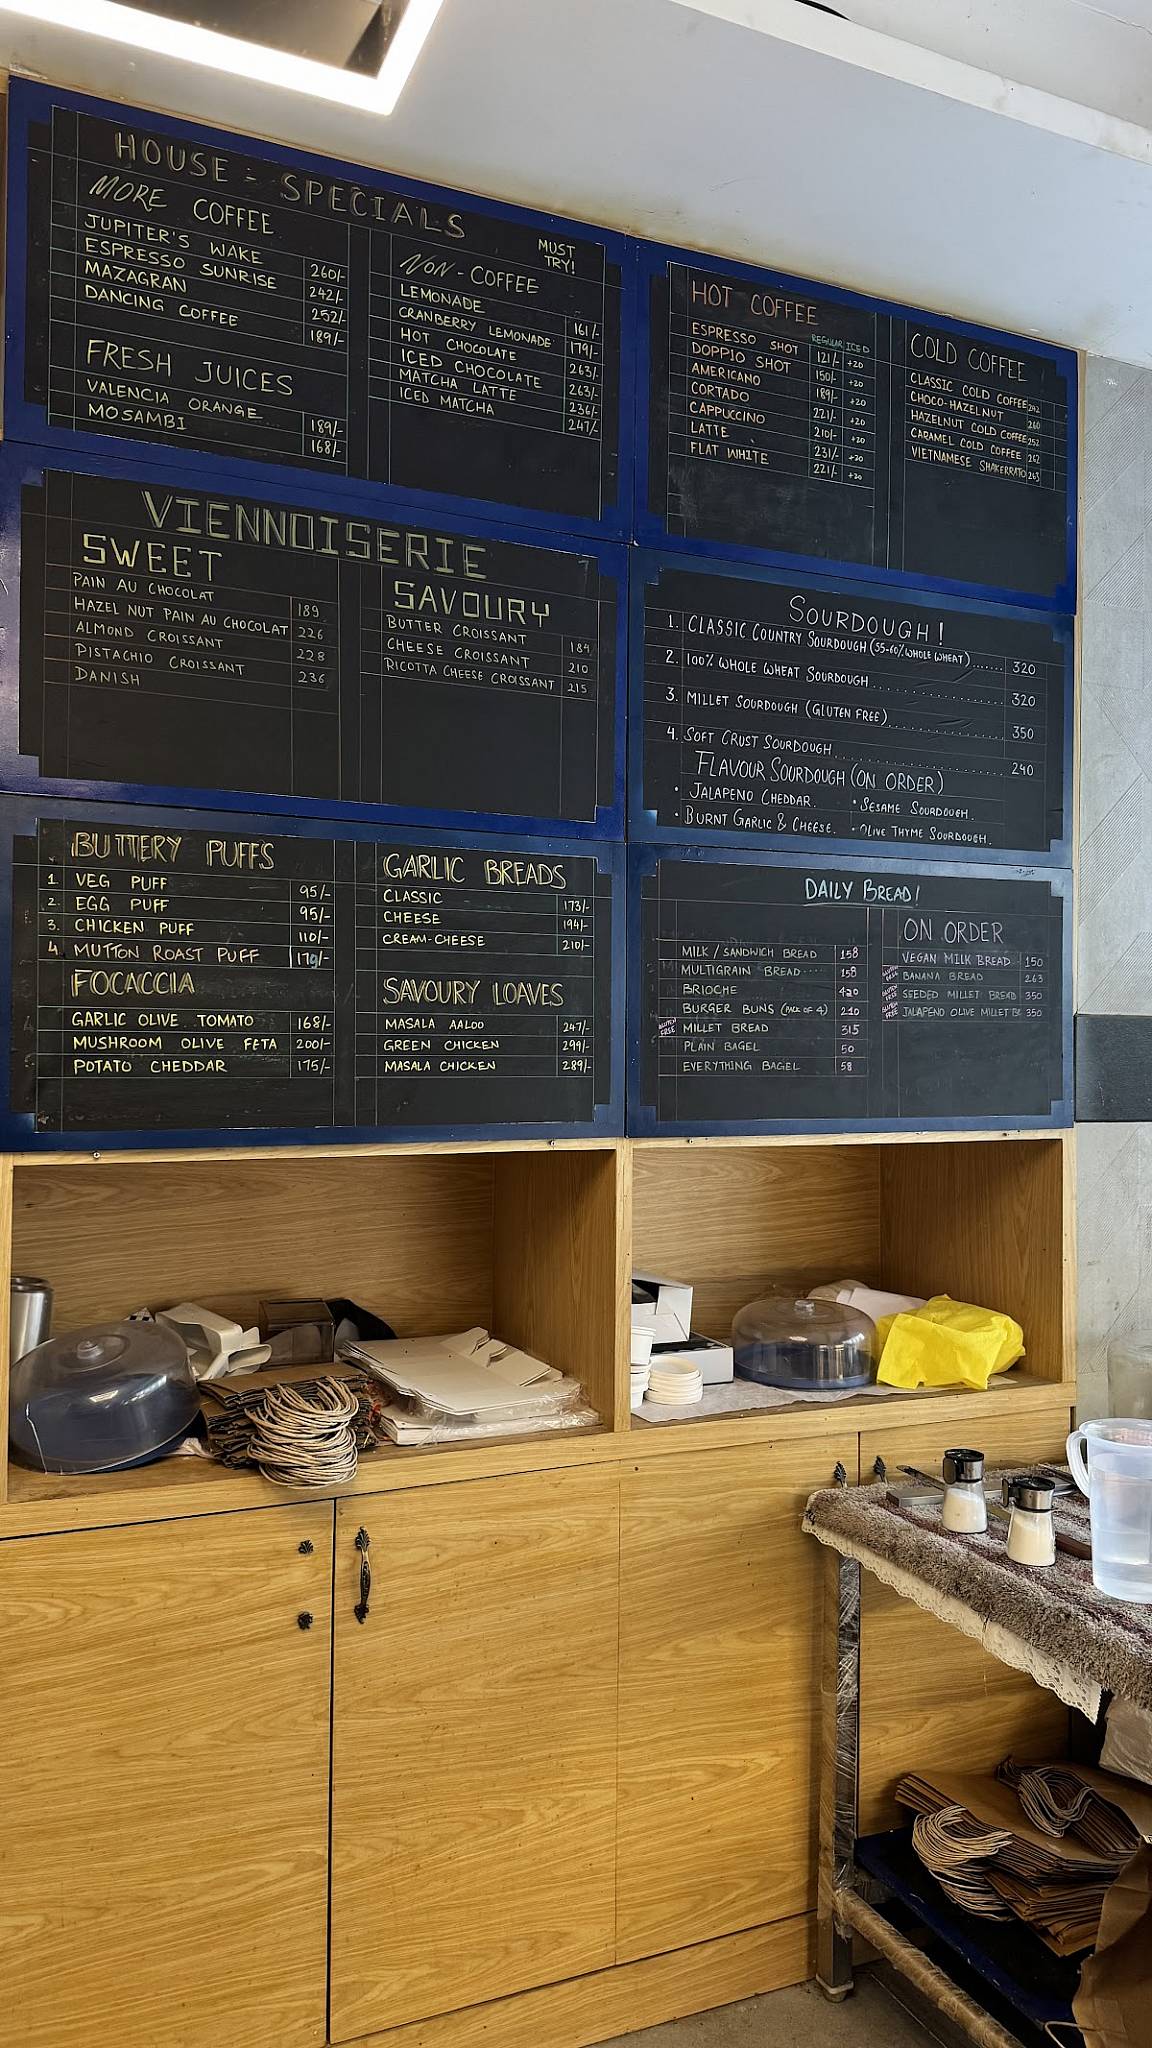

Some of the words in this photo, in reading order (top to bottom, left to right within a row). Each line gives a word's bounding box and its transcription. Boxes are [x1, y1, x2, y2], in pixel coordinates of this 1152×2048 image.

[115, 132, 229, 182] HOUSE
[281, 174, 465, 238] SPECIALS
[89, 175, 167, 212] MORE
[193, 199, 274, 234] COFFEE
[85, 214, 190, 248] JUPITER'S
[210, 242, 263, 264] WAKE
[311, 264, 345, 282] 260/-
[538, 239, 575, 257] MUST
[85, 238, 185, 268] ESPRESSO
[200, 263, 277, 289] SUNRISE
[545, 255, 575, 274] TRY!
[85, 260, 187, 292] MAZAGRAN
[311, 308, 346, 324] 252/-
[470, 266, 539, 294] COFFEE
[85, 285, 164, 311] DANCING
[179, 305, 239, 326] COFFEE
[400, 283, 485, 314] LEMONADE
[574, 323, 599, 339] 161/-
[692, 280, 733, 308] HOT
[751, 294, 819, 326] COFFEE
[399, 307, 476, 332] CRANBERRY
[489, 327, 552, 347] LEMONADE
[401, 328, 430, 344] HOT
[447, 339, 516, 361] CHOCOLATE
[692, 322, 756, 344] ESPRESSO
[770, 341, 798, 355] SHOT
[817, 351, 839, 366] 121/-
[692, 342, 745, 363] DOPPIO
[755, 356, 791, 374] SHOT
[911, 333, 957, 364] COLD
[968, 348, 1028, 382] COFFEE
[87, 339, 171, 376] FRESH
[195, 362, 293, 395] JUICES
[692, 362, 760, 385] AMERICANO
[87, 379, 169, 404] VALENCIA
[189, 398, 263, 419] ORANGE
[400, 369, 457, 389] MATCHA
[473, 383, 516, 400] LATTE
[691, 382, 750, 402] CORTADO
[911, 373, 953, 392] CLASSIC
[963, 385, 990, 399] COLD
[997, 394, 1027, 409] COFFEE
[88, 403, 187, 430] MOSAMBI
[400, 387, 429, 404] ICED
[440, 396, 494, 416] MATCHA
[690, 402, 765, 424] CAPPUCCINO
[911, 391, 1003, 422] CHOCO-HAZELNUT
[690, 442, 719, 456] FLAT
[728, 448, 769, 465] WHITE
[911, 446, 972, 468] VIETNAMESE
[141, 490, 487, 580] VIENNOISERIE
[83, 533, 222, 582] SWEET
[73, 572, 105, 588] PAIN
[117, 578, 137, 593] AU
[149, 583, 214, 602] CHOCOLAT
[298, 604, 319, 618] 189
[394, 581, 550, 628] SAVOURY
[74, 597, 119, 615] HAZEL
[128, 604, 154, 618] NUT
[163, 608, 195, 623] PAIN
[201, 612, 216, 626] AU
[223, 617, 289, 636] CHOCOLAT
[298, 626, 324, 640] 226
[386, 615, 442, 634] BUTTER
[453, 624, 527, 645] CROISSANT
[75, 643, 153, 664] PISTACHIO
[169, 656, 245, 676] CROISSANT
[688, 615, 746, 638] CLASSIC
[752, 623, 802, 644] COUNTRY
[807, 631, 867, 653] SOURDOUGH
[1012, 661, 1036, 675] 320
[75, 666, 140, 686] DANISH
[687, 654, 714, 666] 100%
[719, 656, 757, 673] WHOLE
[763, 662, 800, 678] WHEAT
[806, 666, 868, 687] SOURDOUGH
[687, 691, 729, 706] MILLET
[736, 695, 798, 714] SOURDOUGH
[1012, 726, 1034, 739] 350
[684, 727, 714, 744] SOFT
[721, 730, 759, 748] CRUST
[763, 735, 832, 755] SOURDOUGH
[1012, 762, 1034, 776] 240
[695, 750, 765, 781] FLAVOUR
[770, 756, 845, 786] SOURDOUGH
[851, 762, 876, 788] (ON
[886, 771, 944, 795] ORDER)
[684, 805, 728, 825] BURNT
[778, 813, 786, 831] &
[71, 831, 182, 862] BUTTERY
[206, 839, 274, 870] PUFFS
[76, 872, 110, 888] VEG
[131, 875, 168, 891] PUFF
[300, 885, 331, 900] 95/-
[383, 853, 465, 883] GARLIC
[484, 859, 567, 889] BREADS
[383, 889, 443, 905] CLASSIC
[564, 899, 590, 913] 173/-
[805, 878, 853, 900] DAILY
[863, 878, 920, 906] BREAD!
[74, 918, 144, 935] CHICKEN
[160, 922, 194, 936] PUFF
[299, 931, 329, 944] 110/-
[384, 911, 441, 924] CHEESE
[904, 918, 932, 941] ON
[944, 921, 1004, 944] ORDER
[74, 943, 140, 960] MUTTON
[154, 947, 204, 962] ROAST
[218, 948, 260, 963] PUFF
[383, 934, 485, 946] CREAM-CHEESE
[681, 964, 750, 976] MULTIGRAIN
[764, 966, 800, 976] BREAD
[902, 952, 936, 964] VEGAN
[944, 952, 971, 965] MILK
[976, 955, 1011, 966] BREAD
[1025, 957, 1043, 968] 150
[71, 968, 195, 998] FOCACCIA
[683, 984, 738, 995] BRIOCHE
[903, 972, 941, 981] BANANA
[949, 972, 983, 981] BREAD
[383, 977, 480, 1005] SAVOURY
[492, 982, 564, 1007] LOAVES
[72, 1012, 126, 1028] GARLIC
[138, 1013, 179, 1028] OLIVE
[197, 1014, 253, 1028] TOMATO
[683, 1003, 733, 1014] BURGER
[743, 1003, 774, 1014] BUNS
[385, 1018, 435, 1030] MASALA
[449, 1020, 484, 1030] AALOO
[563, 1019, 590, 1035] 247/-
[683, 1023, 722, 1033] MILLET
[732, 1023, 769, 1033] BREAD
[841, 1025, 860, 1035] 315
[74, 1036, 162, 1050] MUSHROOM
[182, 1038, 224, 1049] OLIVE
[244, 1040, 277, 1050] FETA
[384, 1040, 430, 1051] GREEN
[444, 1040, 499, 1050] CHICKEN
[684, 1041, 714, 1051] PLAIN
[724, 1041, 760, 1051] BAGEL
[841, 1045, 854, 1053] 50
[74, 1060, 132, 1074] POTATO
[151, 1060, 228, 1073] CHEDDAR
[683, 1061, 752, 1071] EVERYTHING
[762, 1061, 800, 1071] BAGEL
